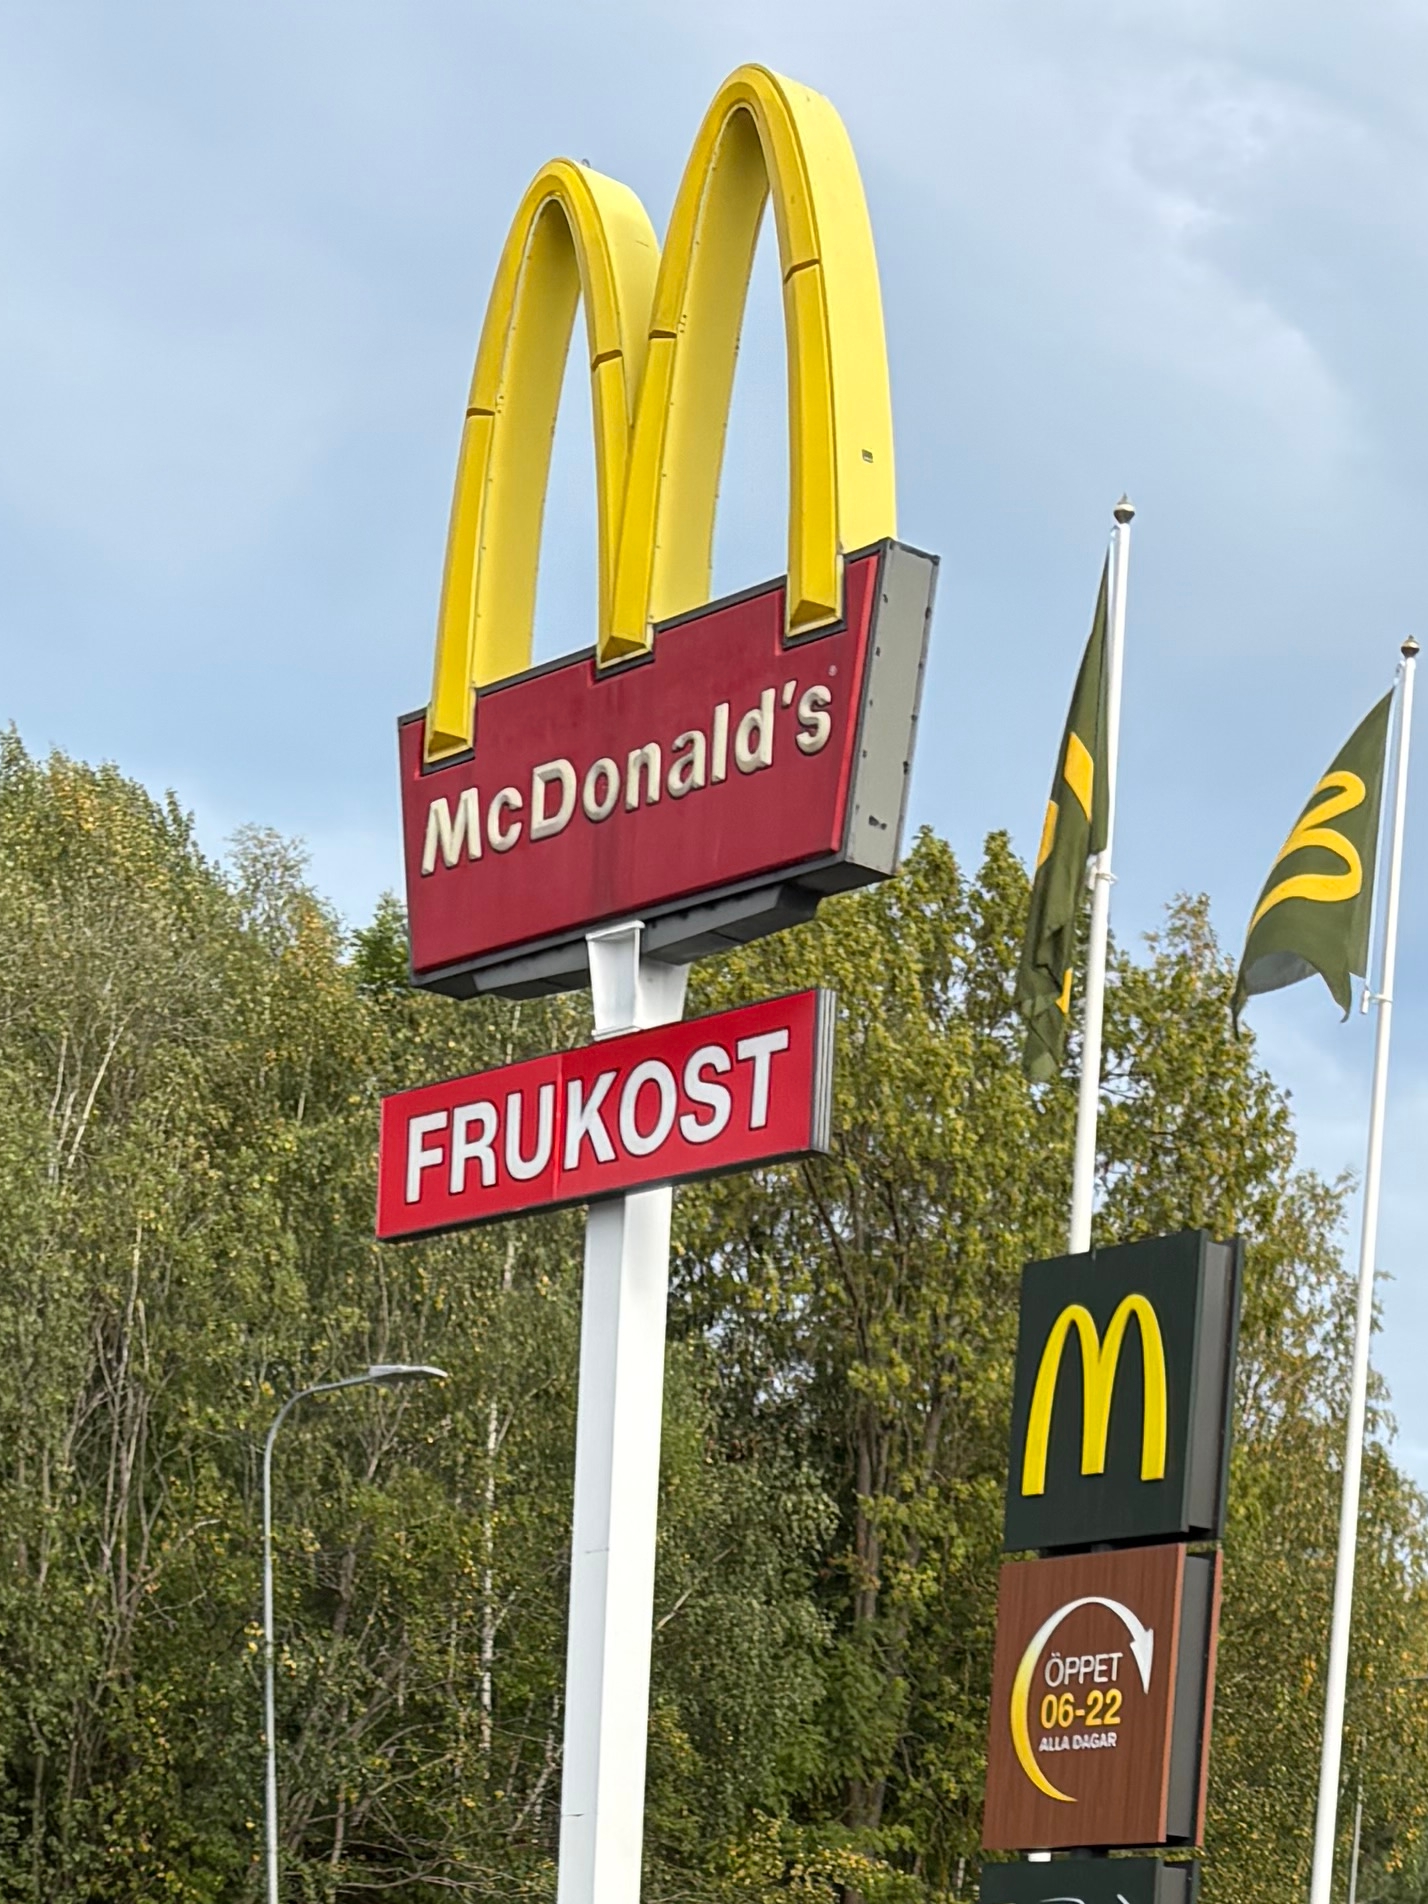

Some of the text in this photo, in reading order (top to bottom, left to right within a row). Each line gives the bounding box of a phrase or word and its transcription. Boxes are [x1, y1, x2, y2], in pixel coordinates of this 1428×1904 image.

[421, 680, 833, 876] McDonald's
[405, 1028, 790, 1204] FRUKOST
[1044, 1652, 1124, 1688] ÖPPET
[1041, 1688, 1123, 1729] 06-22
[1038, 1732, 1118, 1753] ALLA DAGAR
